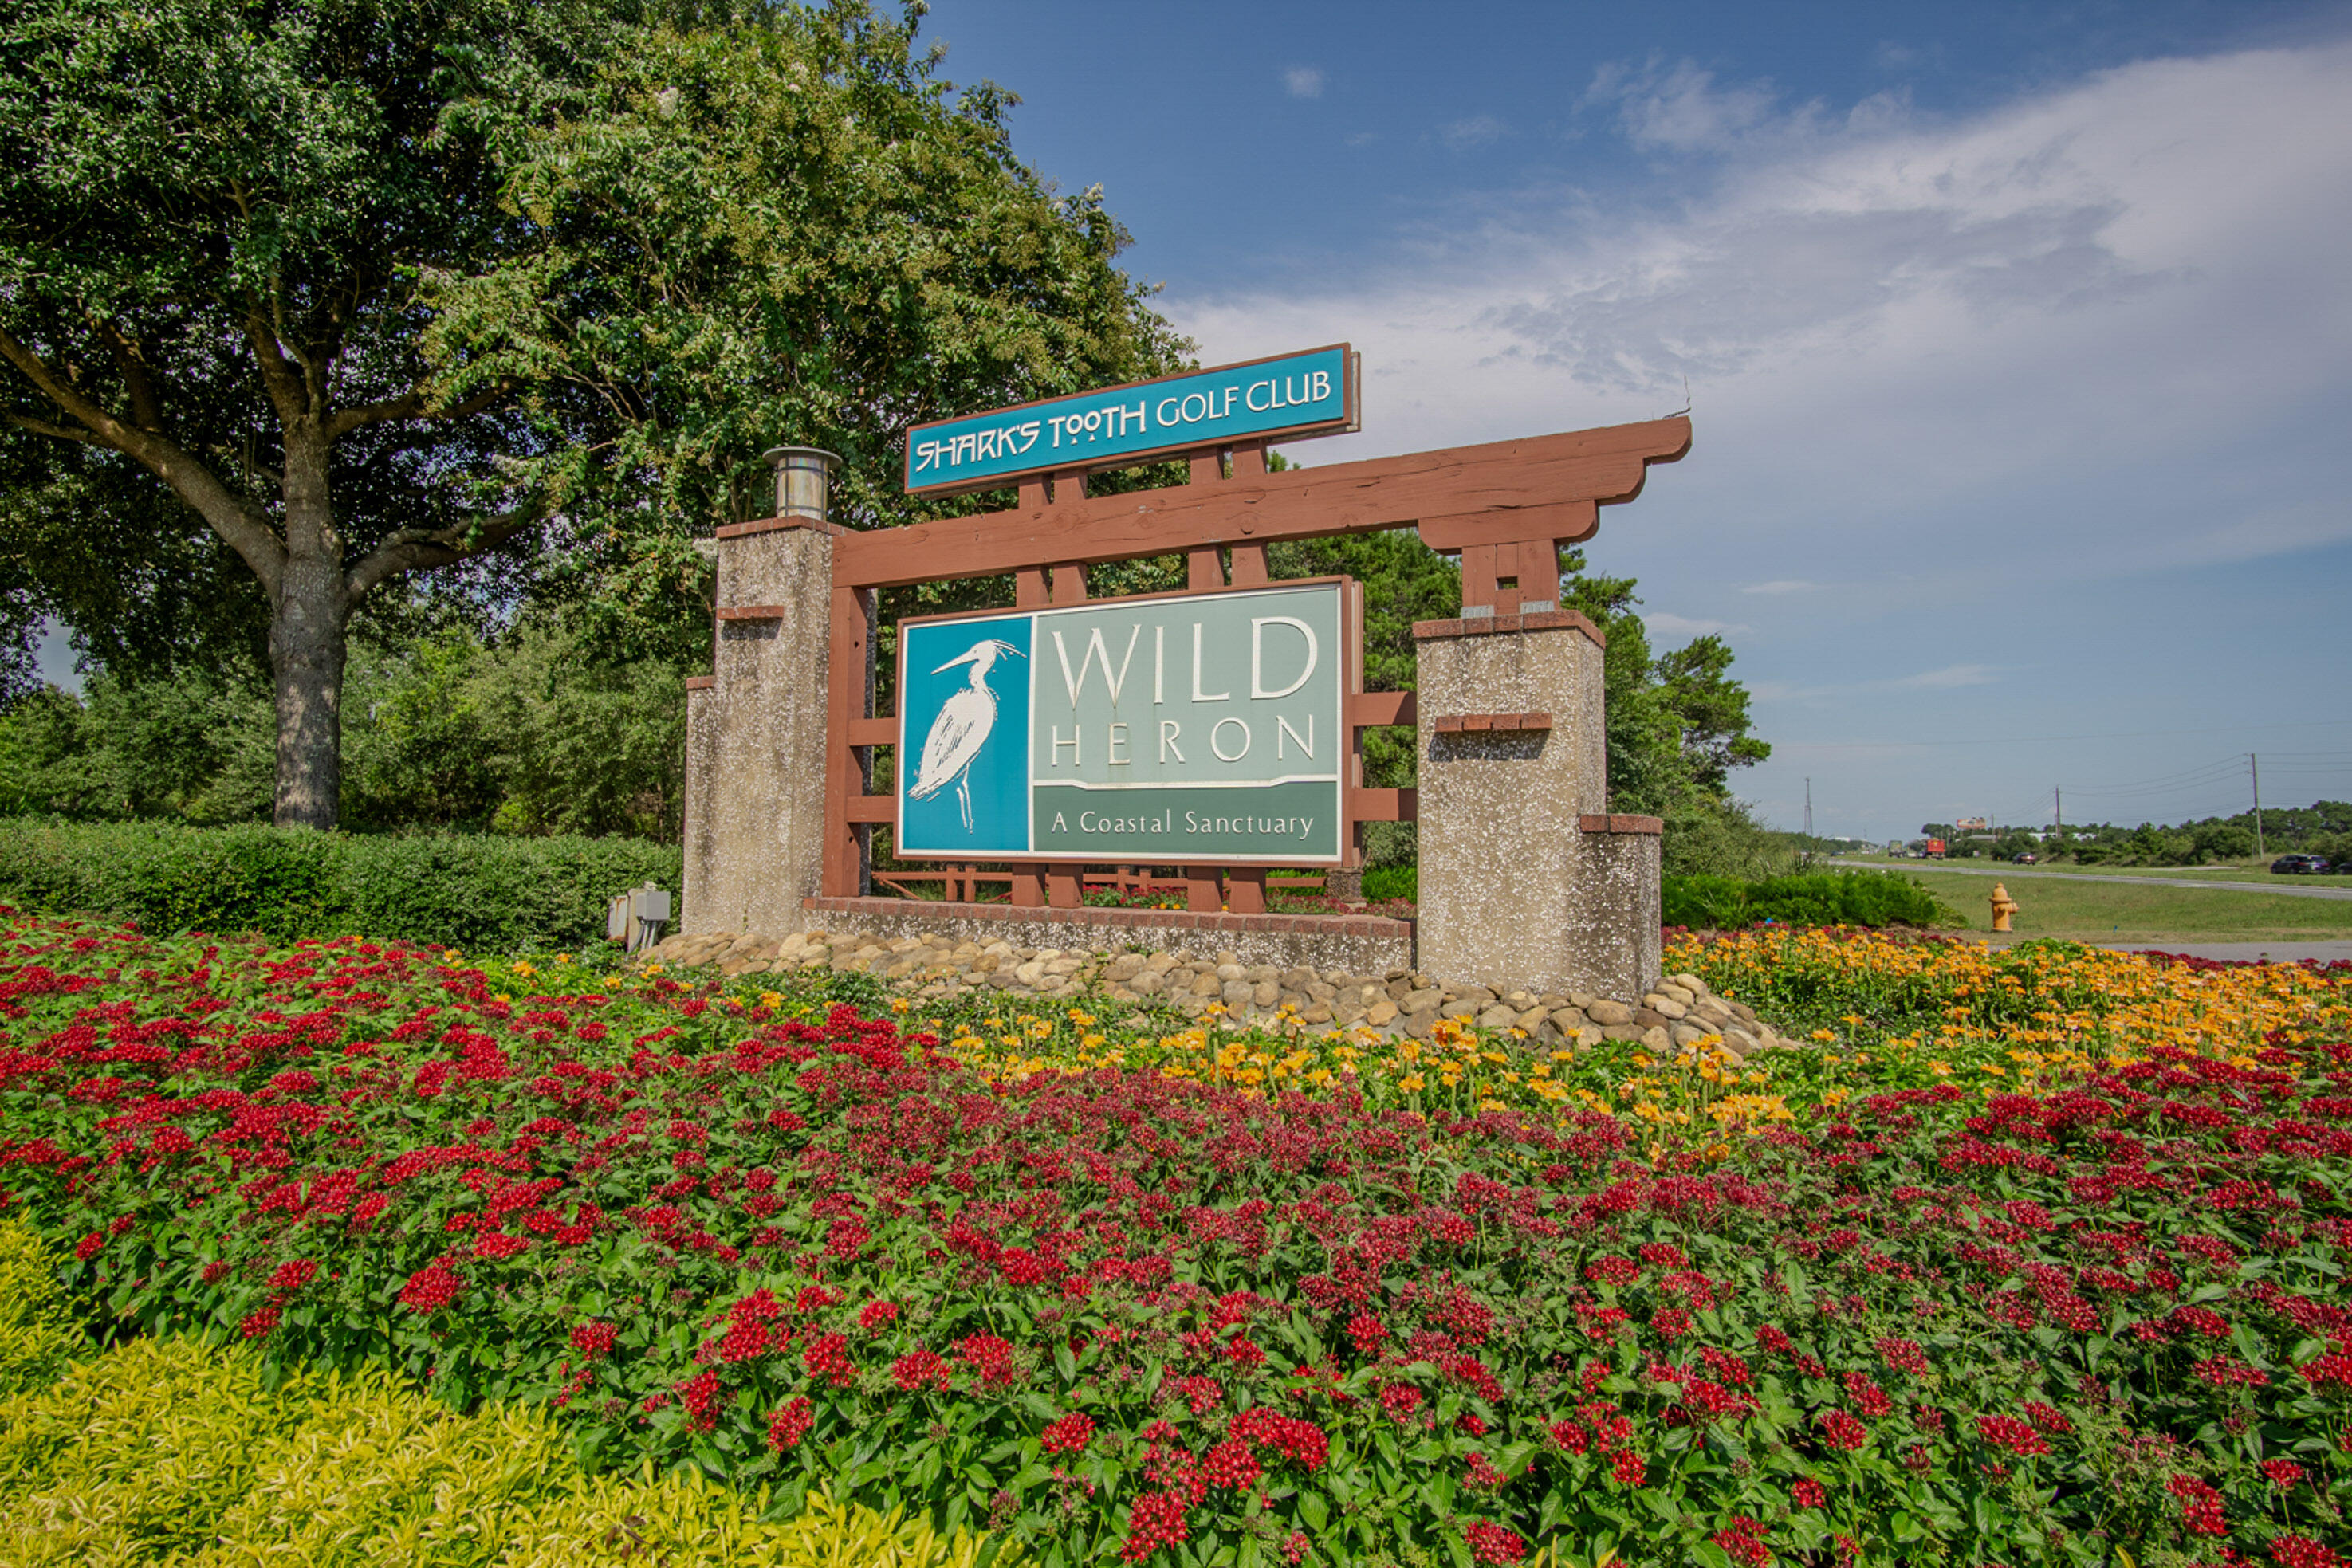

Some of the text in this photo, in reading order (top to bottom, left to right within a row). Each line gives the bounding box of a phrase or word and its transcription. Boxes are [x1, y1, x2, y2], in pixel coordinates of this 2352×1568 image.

[915, 370, 1332, 473] SHARK'S TOOTH GOLF CLUB
[1052, 616, 1319, 710] WILD
[1052, 713, 1314, 767] HERON
[1051, 808, 1315, 841] A Coastal Sanctuary
